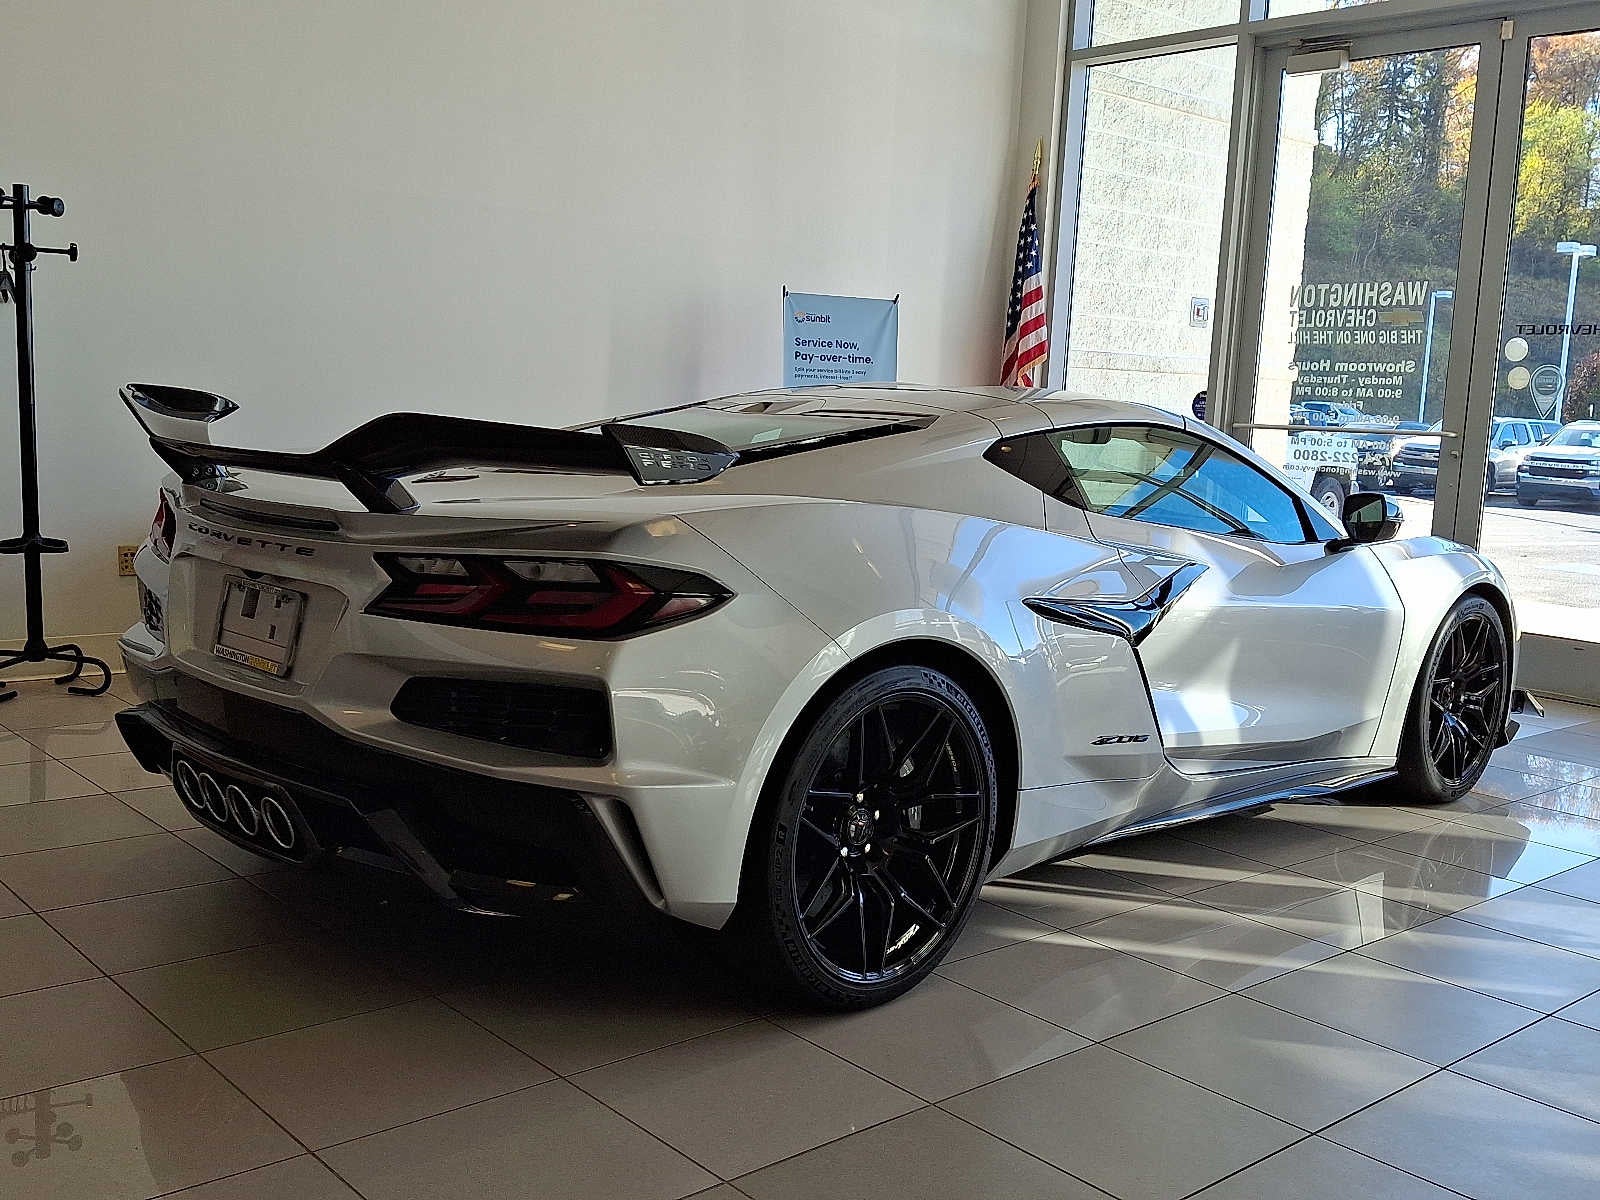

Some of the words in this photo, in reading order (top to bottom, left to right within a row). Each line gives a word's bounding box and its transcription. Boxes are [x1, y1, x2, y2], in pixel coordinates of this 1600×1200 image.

[805, 314, 831, 324] sunbit
[794, 337, 834, 349] Service
[835, 340, 860, 351] Now,
[794, 351, 874, 365] Pay-over-time.
[187, 522, 316, 557] CORVETTE
[1089, 734, 1150, 746] Z06
